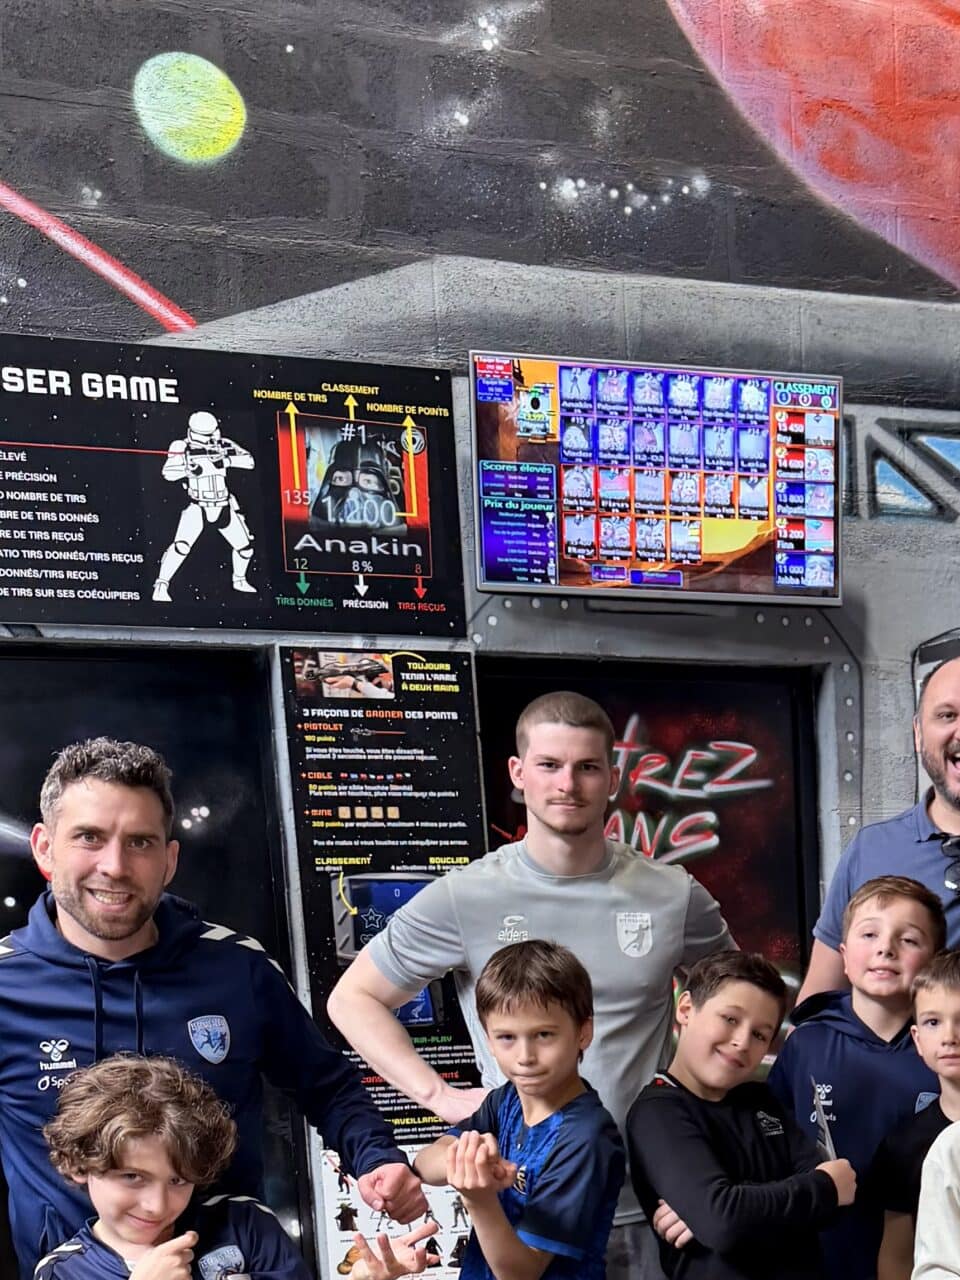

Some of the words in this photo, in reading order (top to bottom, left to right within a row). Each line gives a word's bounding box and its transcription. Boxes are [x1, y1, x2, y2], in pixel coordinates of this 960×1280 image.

[2, 368, 71, 396] SER
[82, 374, 179, 403] GAME
[322, 383, 380, 396] CLASSEMENT
[775, 382, 836, 395] CLASSEMENT
[254, 389, 292, 401] NOMBRE
[294, 392, 306, 402] DE
[308, 393, 328, 404] TIRS
[367, 403, 403, 415] NOMBRE
[405, 405, 416, 415] DE
[418, 406, 449, 417] POINTS
[341, 423, 366, 445] #1
[483, 462, 517, 472] Scores
[5, 470, 57, 483] PRÉCISION
[6, 490, 49, 503] NOMBRE
[50, 493, 63, 502] DE
[66, 493, 87, 504] TIRS
[285, 490, 311, 505] 135
[484, 499, 504, 509] Prix
[505, 500, 519, 510] du
[520, 501, 553, 511] joueur
[21, 511, 34, 521] DE
[35, 512, 58, 522] TIRS
[59, 512, 100, 524] DONNÉS
[13, 530, 27, 540] DE
[28, 530, 50, 541] TIRS
[52, 532, 85, 543] REÇUS
[294, 533, 423, 557] Anakin
[22, 550, 43, 560] TIRS
[112, 553, 144, 564] REÇUS
[294, 558, 308, 570] 12
[67, 569, 98, 581] REÇUS
[11, 587, 33, 597] TIRS
[35, 588, 55, 598] SUR
[56, 589, 75, 599] SES
[77, 589, 140, 600] COÉQUIPIERS
[276, 597, 295, 606] TIRS
[342, 598, 389, 610] PRÉCISION
[407, 662, 451, 671] TOUJOURS
[400, 672, 425, 681] TENIR
[409, 683, 431, 692] DEUX
[311, 708, 349, 719] FAÇONS
[351, 709, 364, 718] DE
[365, 709, 403, 718] GAGNER
[405, 710, 424, 719] DES
[425, 711, 458, 720] POINTS
[304, 722, 344, 731] PISTOLET
[307, 771, 333, 780] CIBLE
[315, 857, 372, 865] CLASSEMENT
[429, 857, 470, 865] BOUCLIER
